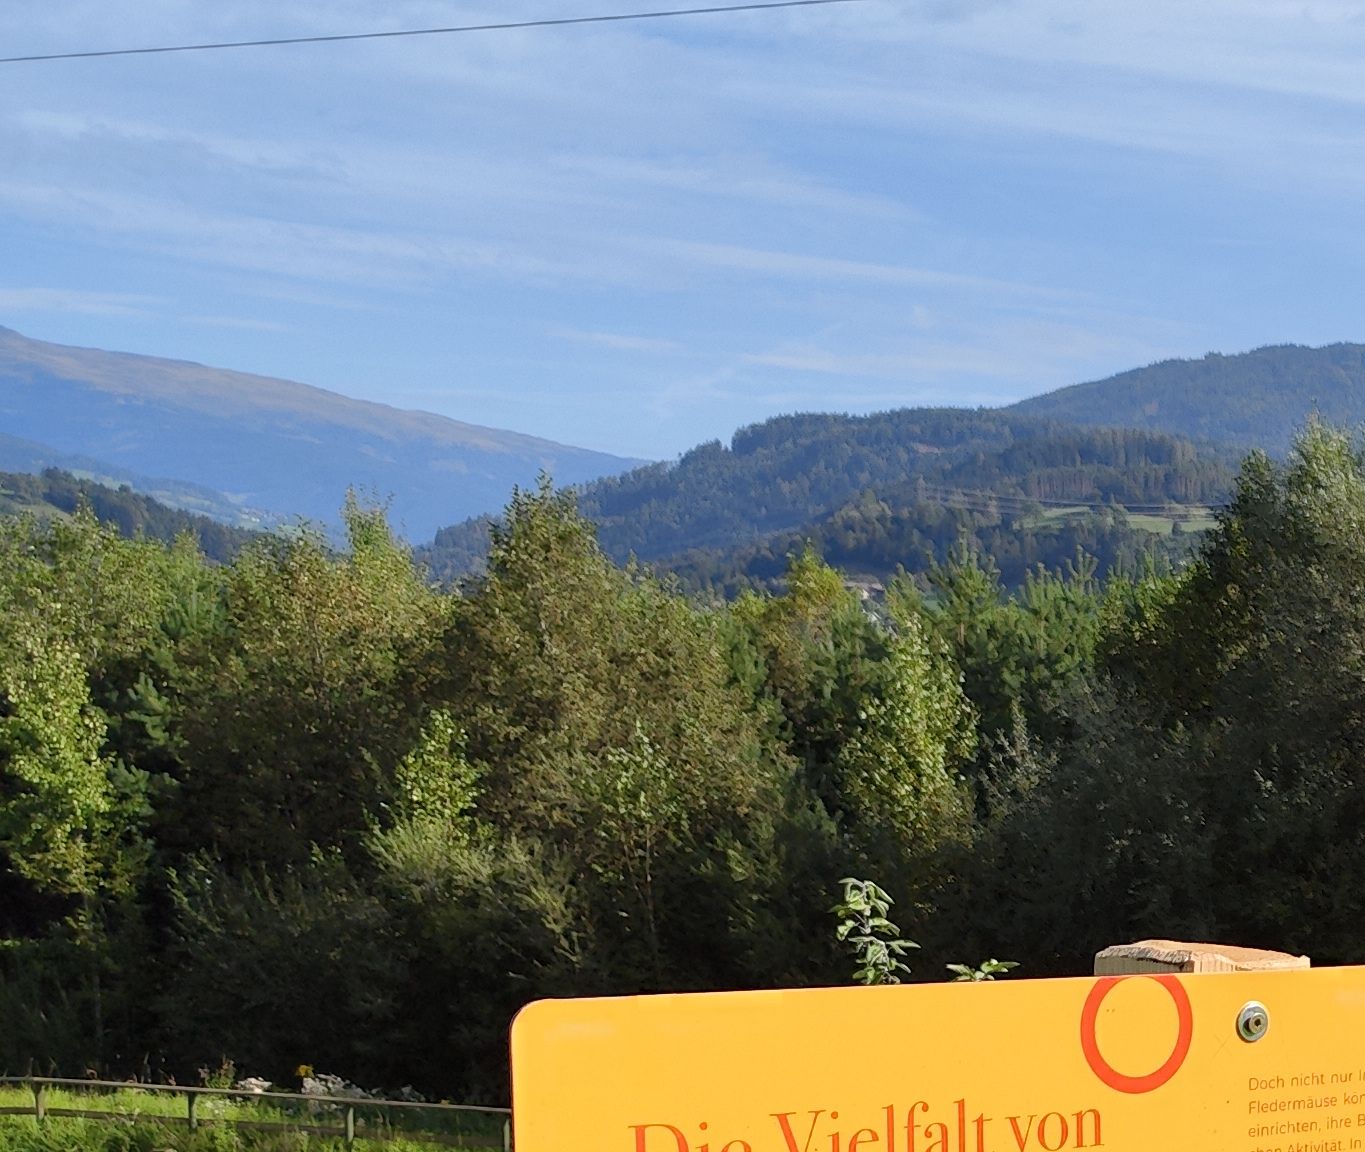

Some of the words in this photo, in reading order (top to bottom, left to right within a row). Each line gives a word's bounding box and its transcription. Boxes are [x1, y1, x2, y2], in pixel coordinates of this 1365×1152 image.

[1249, 1076, 1285, 1090] Doch
[1291, 1073, 1325, 1087] nicht
[1331, 1072, 1352, 1084] nur
[1249, 1096, 1338, 1114] Fledermäuse
[1248, 1120, 1321, 1137] einrichten,
[1327, 1116, 1351, 1130] ihre
[1350, 1138, 1362, 1150] In
